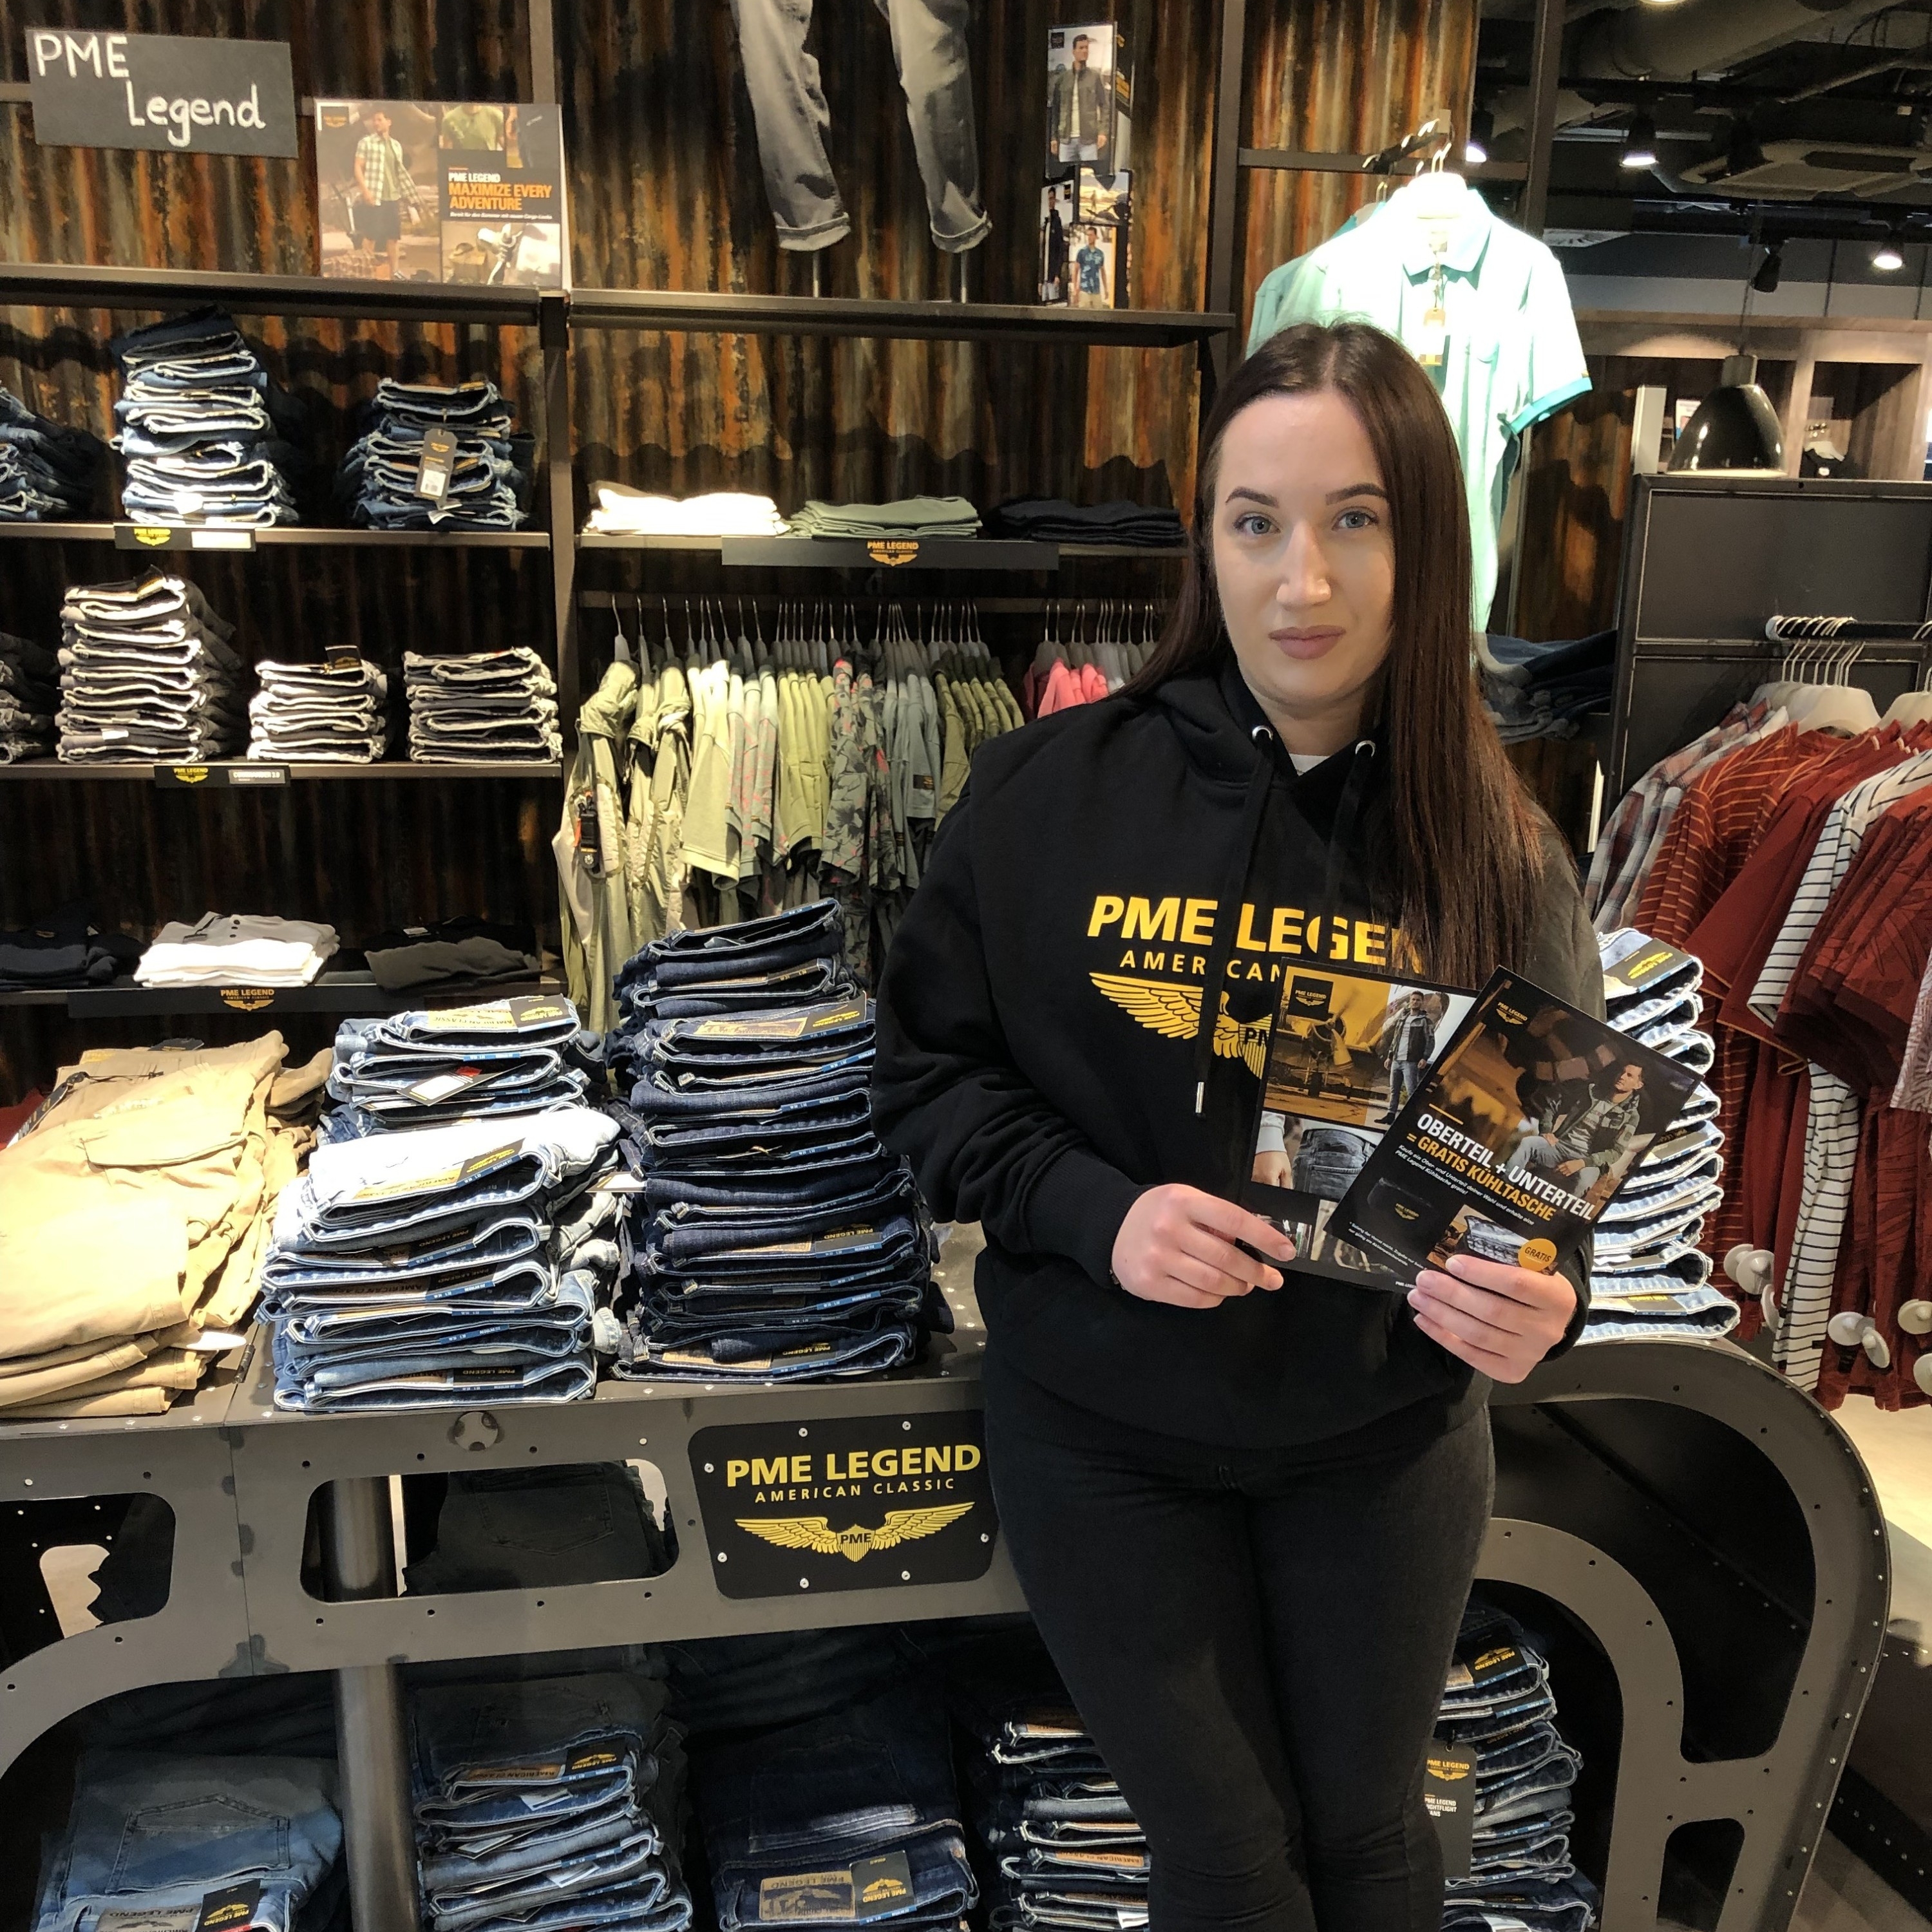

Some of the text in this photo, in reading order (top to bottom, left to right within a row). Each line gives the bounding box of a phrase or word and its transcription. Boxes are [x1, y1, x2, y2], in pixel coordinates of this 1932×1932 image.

[34, 32, 129, 78] PME
[126, 80, 266, 147] Legend
[448, 173, 501, 183] PME LEGEND
[448, 183, 552, 198] MAXIMIZE EVERY
[450, 196, 522, 211] ADVENTURE
[887, 542, 920, 550] LEGEND
[1087, 895, 1425, 974] PME LEGE
[1120, 950, 1280, 982] AMERCAN
[1497, 1001, 1528, 1021] PME LEGEND
[1395, 1150, 1408, 1160] PME
[1406, 1157, 1426, 1170] Legend
[1417, 1113, 1496, 1169] OBERTEIL
[1508, 1166, 1597, 1220] UNTERTEIL
[1399, 1144, 1414, 1155] Kaufe
[1435, 1167, 1446, 1175] und
[1446, 1172, 1468, 1188] Unterteil
[1482, 1193, 1497, 1204] Wahl
[1495, 1202, 1507, 1210] und
[1417, 1136, 1469, 1172] GRATIS
[1467, 1164, 1557, 1222] KÜHLTASCHE
[419, 1234, 450, 1247] LEGEND
[824, 1230, 855, 1240] LEGEND
[1524, 1246, 1552, 1262] GRATIS
[727, 1444, 981, 1487] PME LEGEND
[755, 1478, 954, 1503] AMERICAN CLASSIC
[840, 1533, 872, 1544] PME
[1475, 1651, 1515, 1671] PME LEGEND
[1443, 1761, 1470, 1770] LEGEND
[862, 1887, 907, 1903] PME LEGEND
[109, 1909, 162, 1917] LEGEND
[204, 1910, 250, 1926] PME LEGEND
